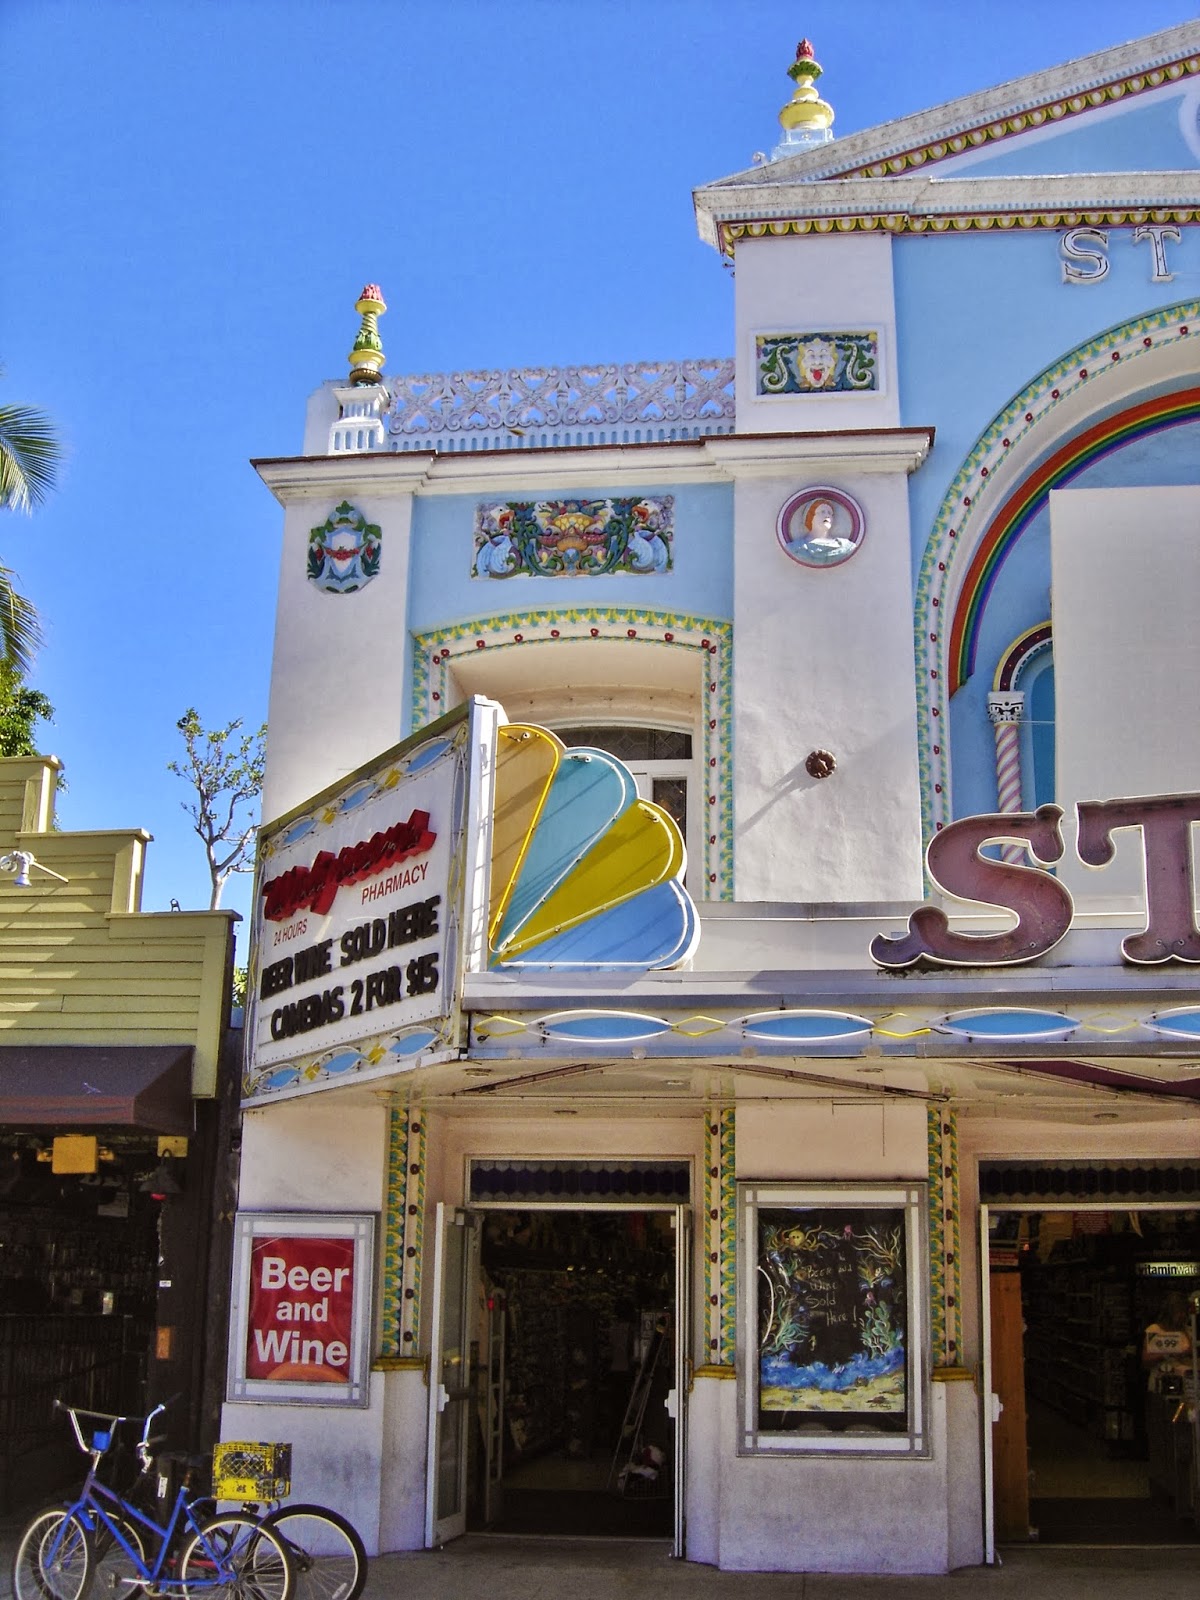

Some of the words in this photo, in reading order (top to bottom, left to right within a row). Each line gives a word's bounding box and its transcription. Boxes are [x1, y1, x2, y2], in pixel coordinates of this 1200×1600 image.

[361, 861, 429, 905] PHARMACY
[273, 929, 283, 947] 24
[281, 918, 308, 943] HOURS
[340, 917, 386, 967] SOLD
[388, 894, 441, 949] HERE
[270, 985, 345, 1041] CAMERAS
[350, 979, 364, 1017] 2
[365, 965, 402, 1011] FOR
[406, 952, 439, 998] $15
[260, 1256, 350, 1293] Beer
[275, 1296, 329, 1323] and
[805, 1290, 837, 1309] Sold
[253, 1328, 348, 1367] Wine
